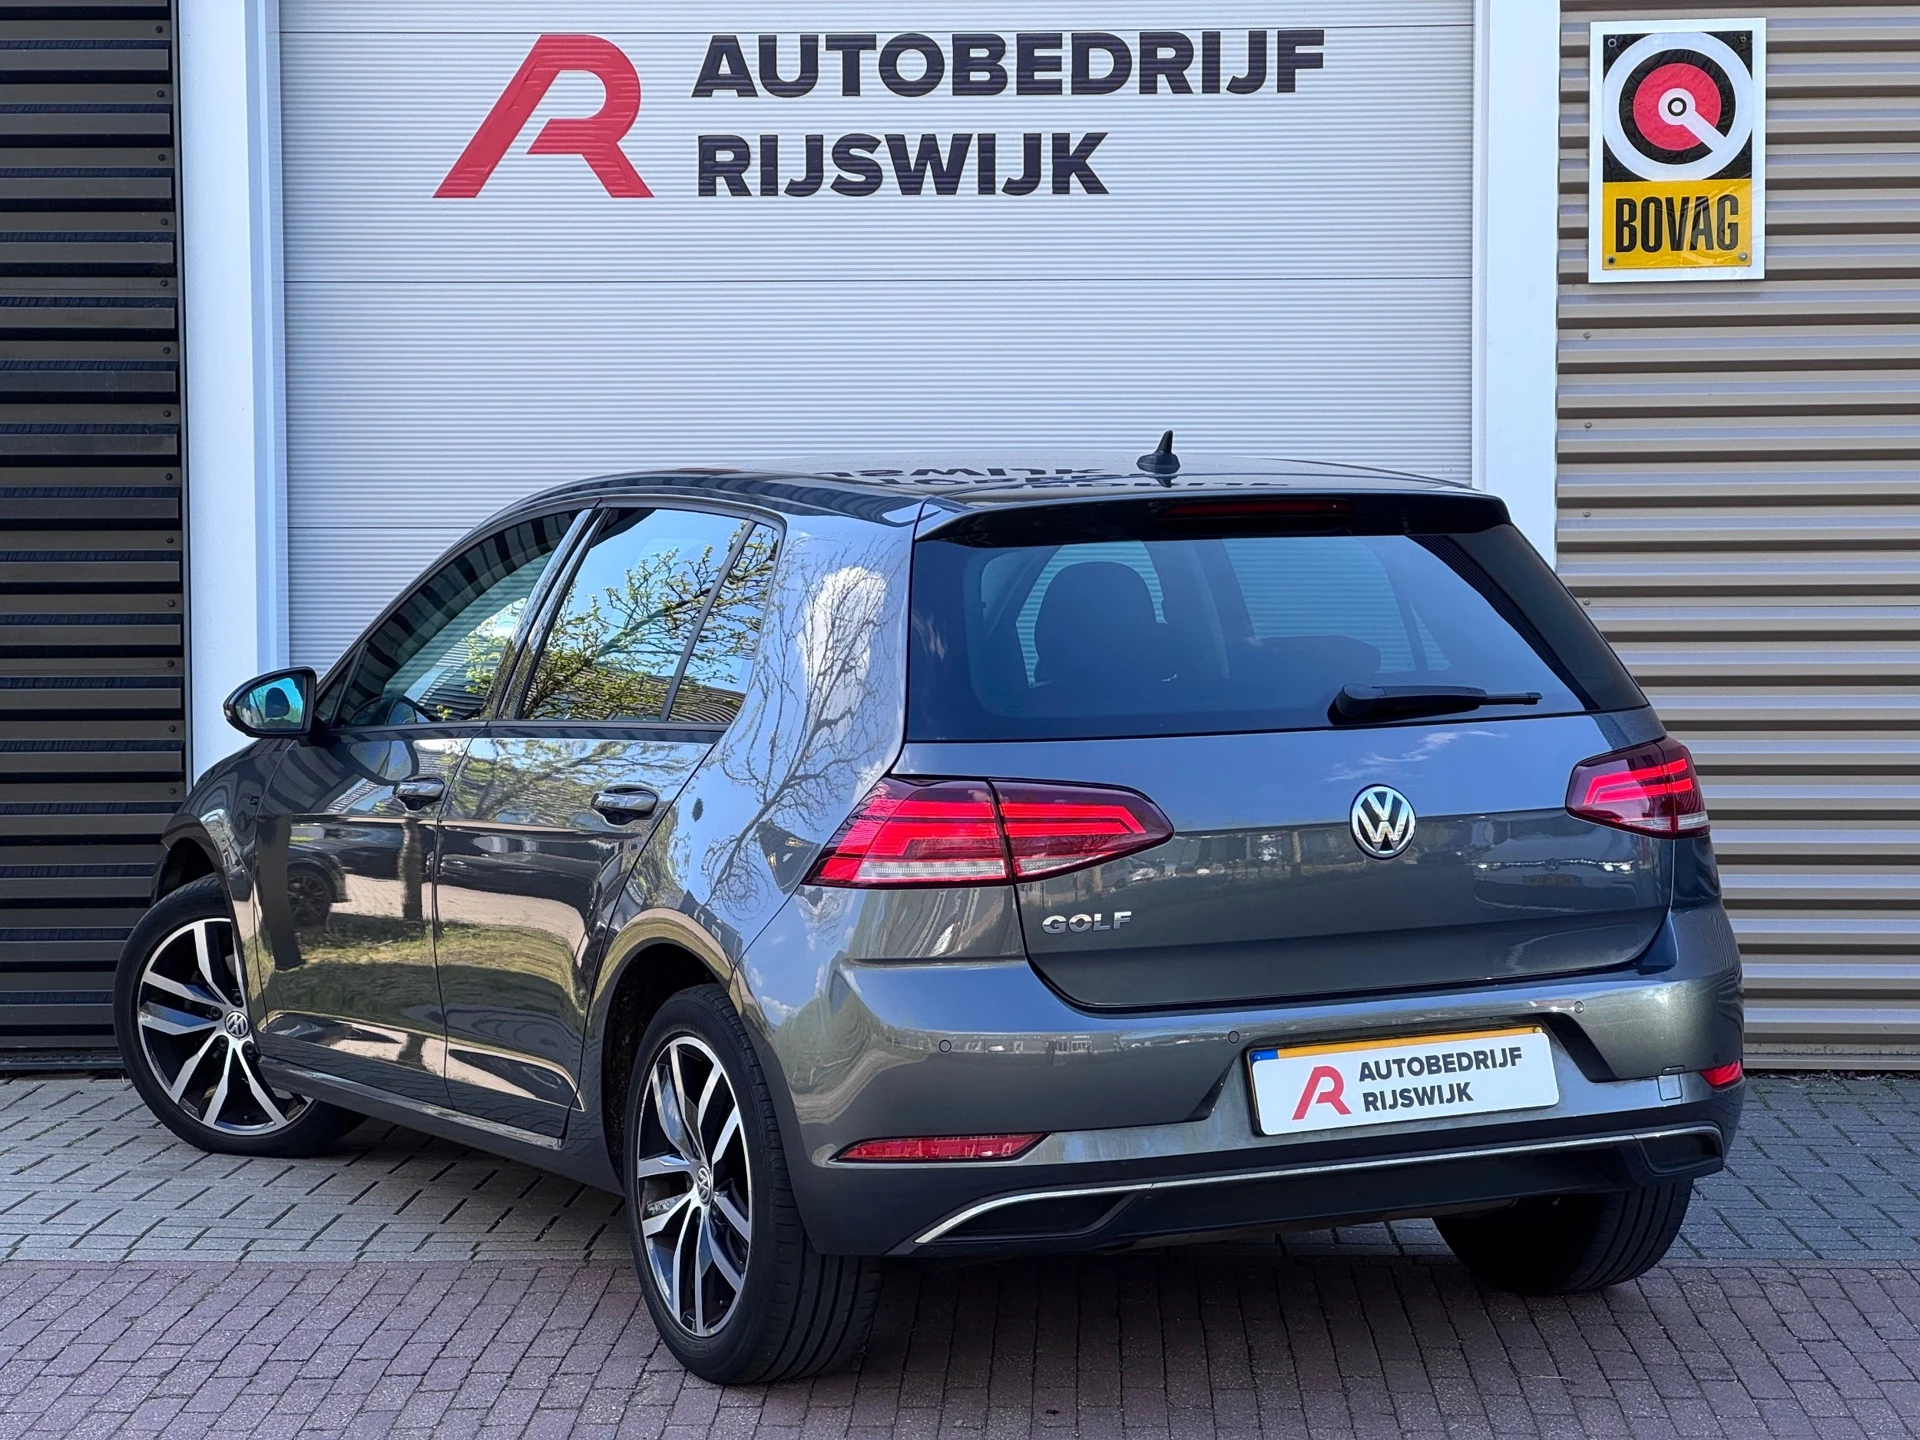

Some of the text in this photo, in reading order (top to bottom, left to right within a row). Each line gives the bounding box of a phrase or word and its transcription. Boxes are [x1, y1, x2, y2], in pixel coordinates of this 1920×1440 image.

[691, 30, 1325, 97] AUTOBEDRIJF
[697, 132, 1109, 198] RIJSWIJK
[1615, 194, 1739, 253] BOVAG
[1351, 784, 1416, 859] VW
[1041, 910, 1132, 934] GOLF
[1358, 1046, 1523, 1082] AUTOBEDRIJF
[1362, 1082, 1474, 1112] RIJSWIJK
